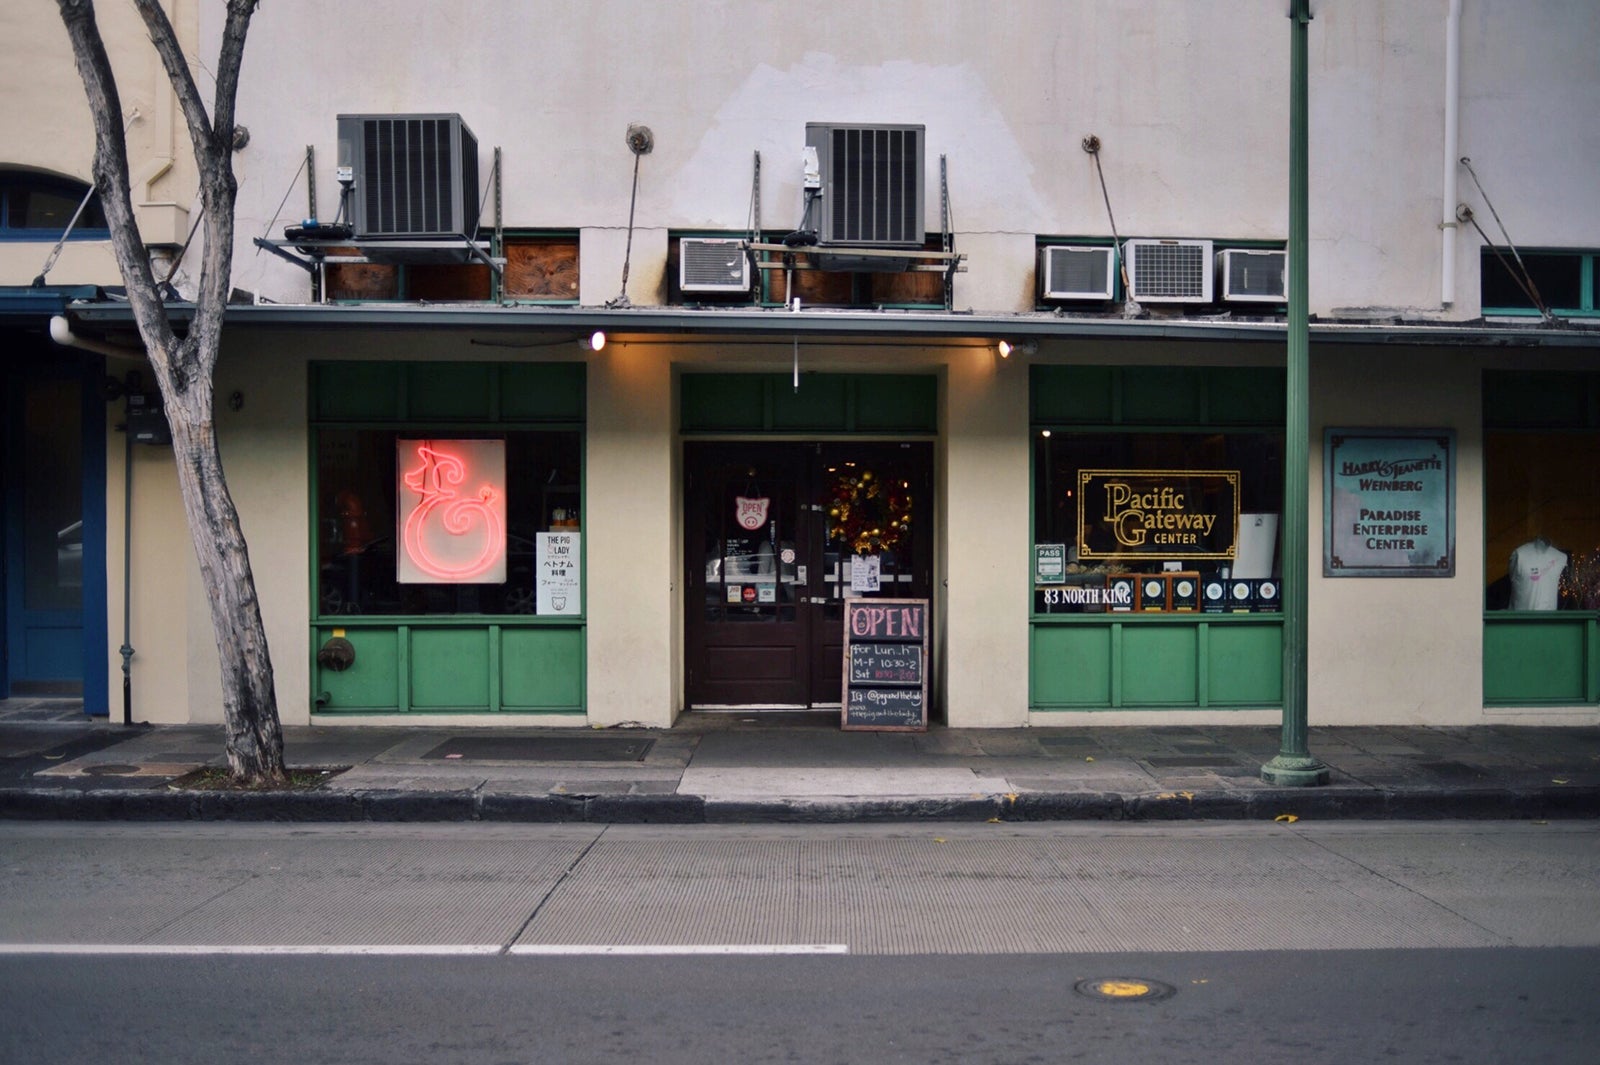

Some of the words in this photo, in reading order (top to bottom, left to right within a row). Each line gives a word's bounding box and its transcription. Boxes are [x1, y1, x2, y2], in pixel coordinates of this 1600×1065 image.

[1342, 459, 1380, 474] HARRY
[1393, 460, 1442, 479] JEANETTE
[1359, 479, 1423, 491] WEINBERG
[742, 503, 762, 512] OPEN
[1104, 483, 1184, 522] Pacific
[1360, 509, 1421, 521] PARADISE
[1114, 509, 1216, 546] Gateway
[1353, 523, 1428, 536] ENTERPRISE
[547, 535, 559, 544] THE
[560, 536, 570, 544] PIG
[1154, 533, 1197, 544] CENTER
[1366, 537, 1415, 550] CENTER
[554, 546, 570, 554] LADY
[1039, 549, 1060, 557] PASS
[543, 560, 574, 568] ベトナム
[1044, 588, 1059, 604] 83
[1062, 588, 1099, 604] NORTH
[1102, 588, 1131, 604] KING
[851, 606, 921, 637] OPEN
[853, 644, 871, 655] for
[874, 645, 910, 656] Lunh
[853, 658, 875, 667] M-F
[855, 669, 870, 679] Sat
